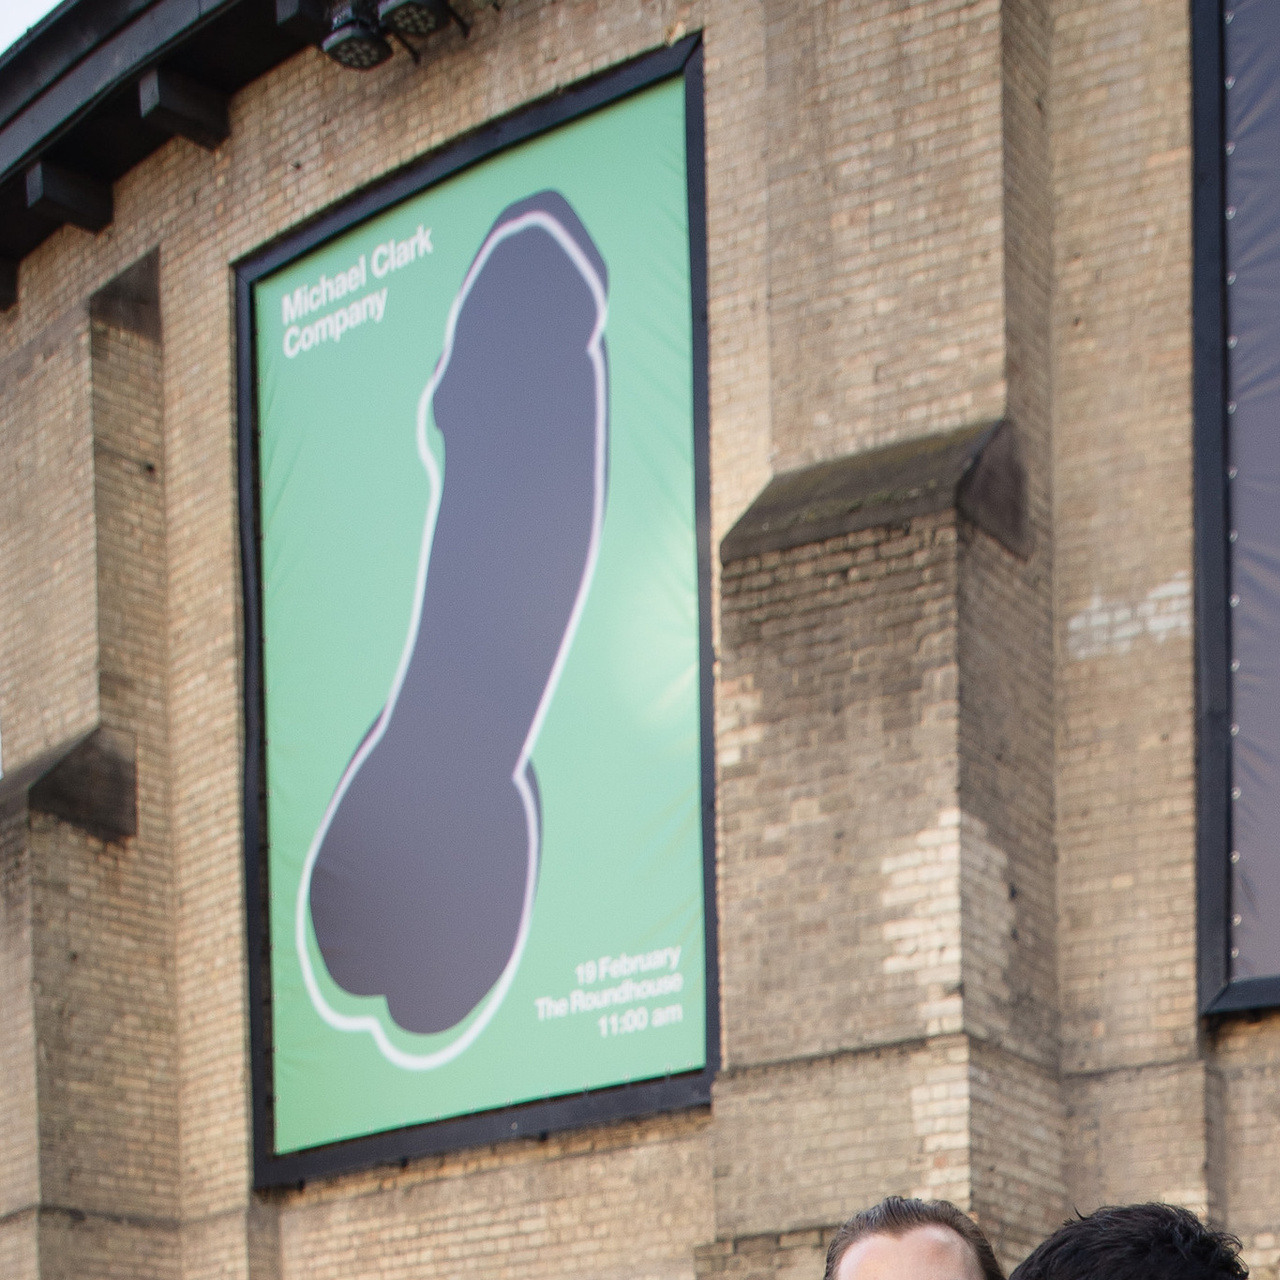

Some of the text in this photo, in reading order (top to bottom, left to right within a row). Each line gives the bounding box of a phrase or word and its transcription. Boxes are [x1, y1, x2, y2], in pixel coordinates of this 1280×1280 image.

[282, 224, 433, 325] Michael Clark
[283, 287, 388, 358] Company
[574, 945, 682, 985] 19 February
[535, 972, 683, 1021] The Roundhouse
[651, 1003, 683, 1028] am
